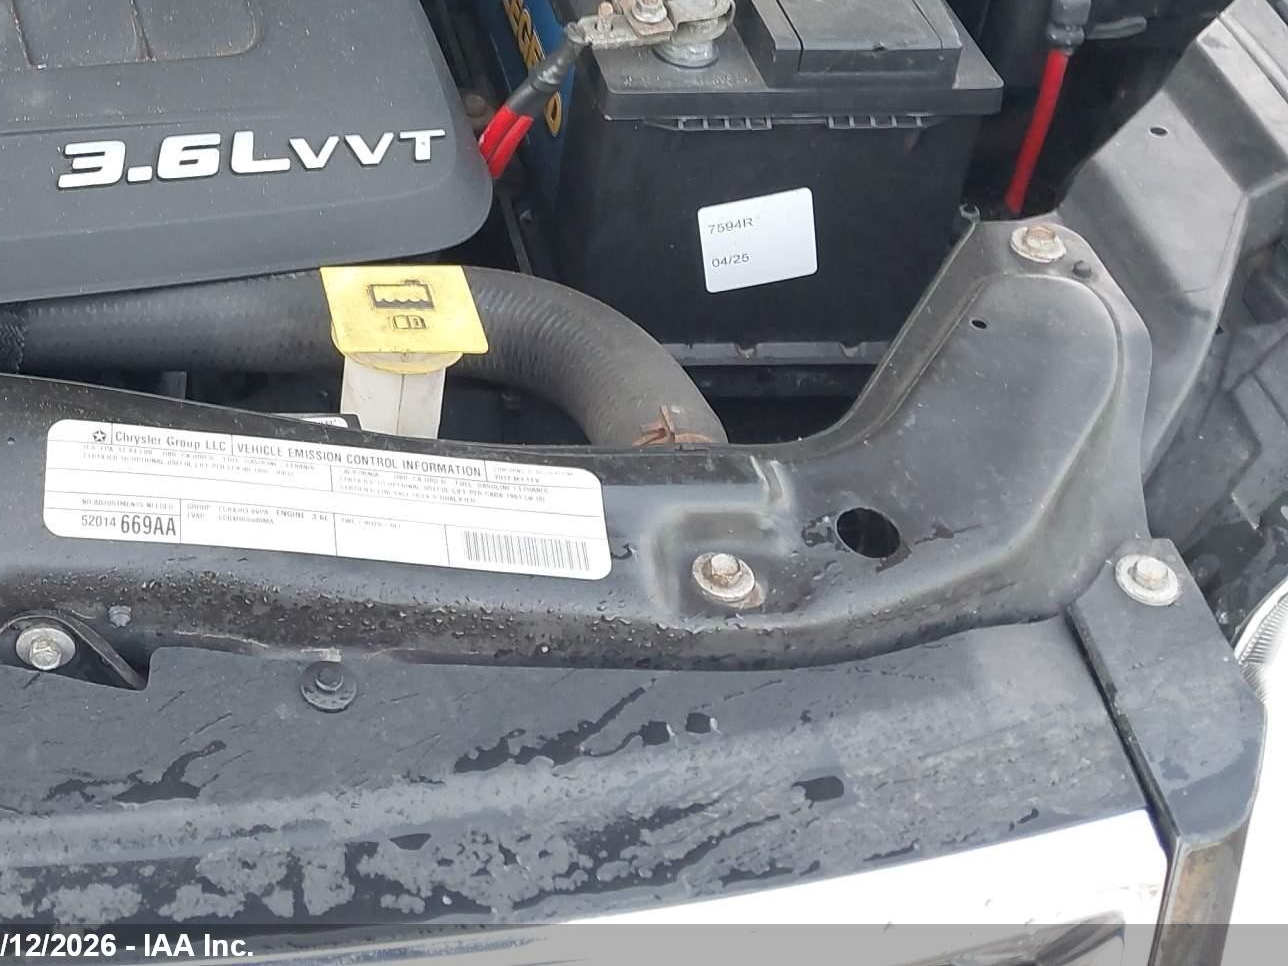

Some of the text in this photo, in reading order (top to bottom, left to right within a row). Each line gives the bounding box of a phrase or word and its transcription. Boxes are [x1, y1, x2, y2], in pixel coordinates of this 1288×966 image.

[708, 217, 754, 234] 7594R
[711, 253, 750, 268] 04/25
[114, 430, 162, 446] Chrysler
[166, 435, 201, 452] Group
[205, 440, 227, 452] LLC
[237, 443, 283, 457] VEHICLE
[288, 447, 343, 464] EMISSION
[346, 454, 398, 470] CONTROL
[402, 460, 482, 478] INFORMATION
[81, 514, 177, 537] 52014 669AA
